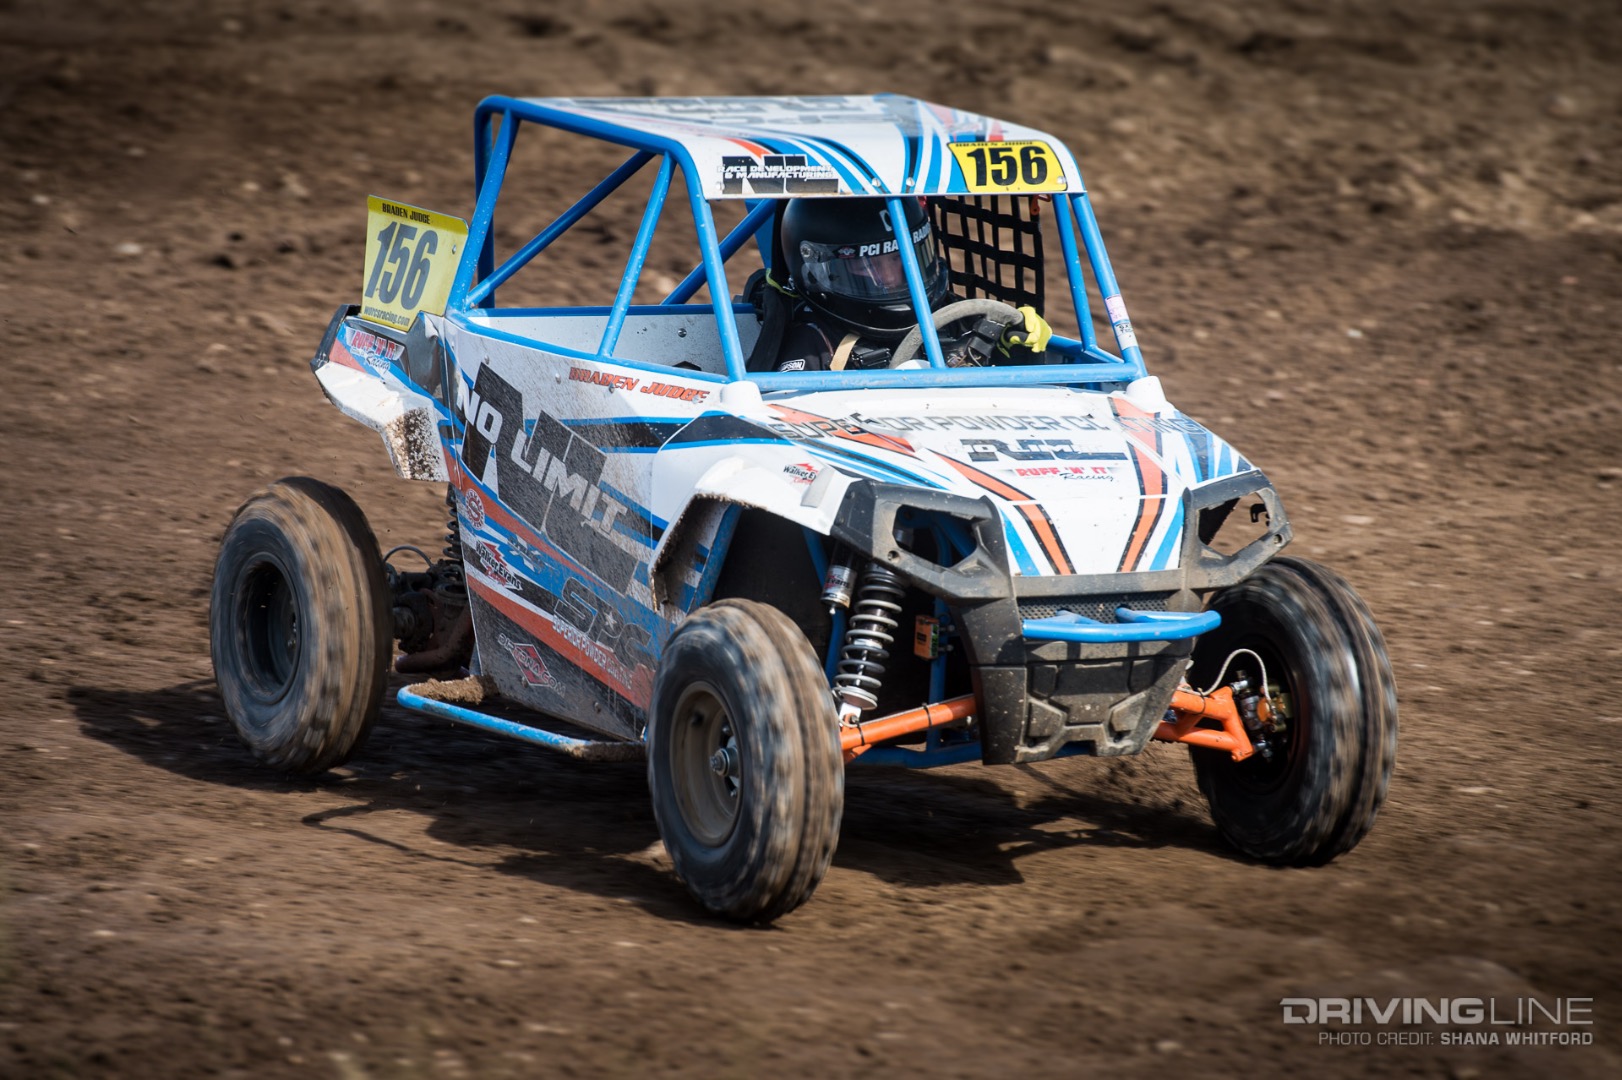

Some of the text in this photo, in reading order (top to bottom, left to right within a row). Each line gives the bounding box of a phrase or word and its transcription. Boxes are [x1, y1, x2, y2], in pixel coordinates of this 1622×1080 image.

[717, 165, 833, 173] RACE DEVELOPMENT
[736, 171, 834, 180] MANUFACTURING
[967, 146, 1047, 186] 156
[382, 202, 431, 225] BRADEN JUDGE
[859, 243, 880, 257] PCI
[365, 221, 438, 310] 156
[363, 305, 410, 326] worcsracing.com
[366, 350, 391, 374] Racing
[569, 366, 710, 404] BRADEN JUDGE
[457, 378, 503, 444] NO
[926, 415, 1072, 432] POWDER
[511, 428, 628, 536] LIMIT
[783, 464, 808, 478] Walker
[1015, 467, 1061, 477] RUFF
[1091, 467, 1108, 475] IT
[1059, 472, 1114, 482] Racing
[476, 540, 500, 571] Walker
[498, 564, 524, 589] Evans
